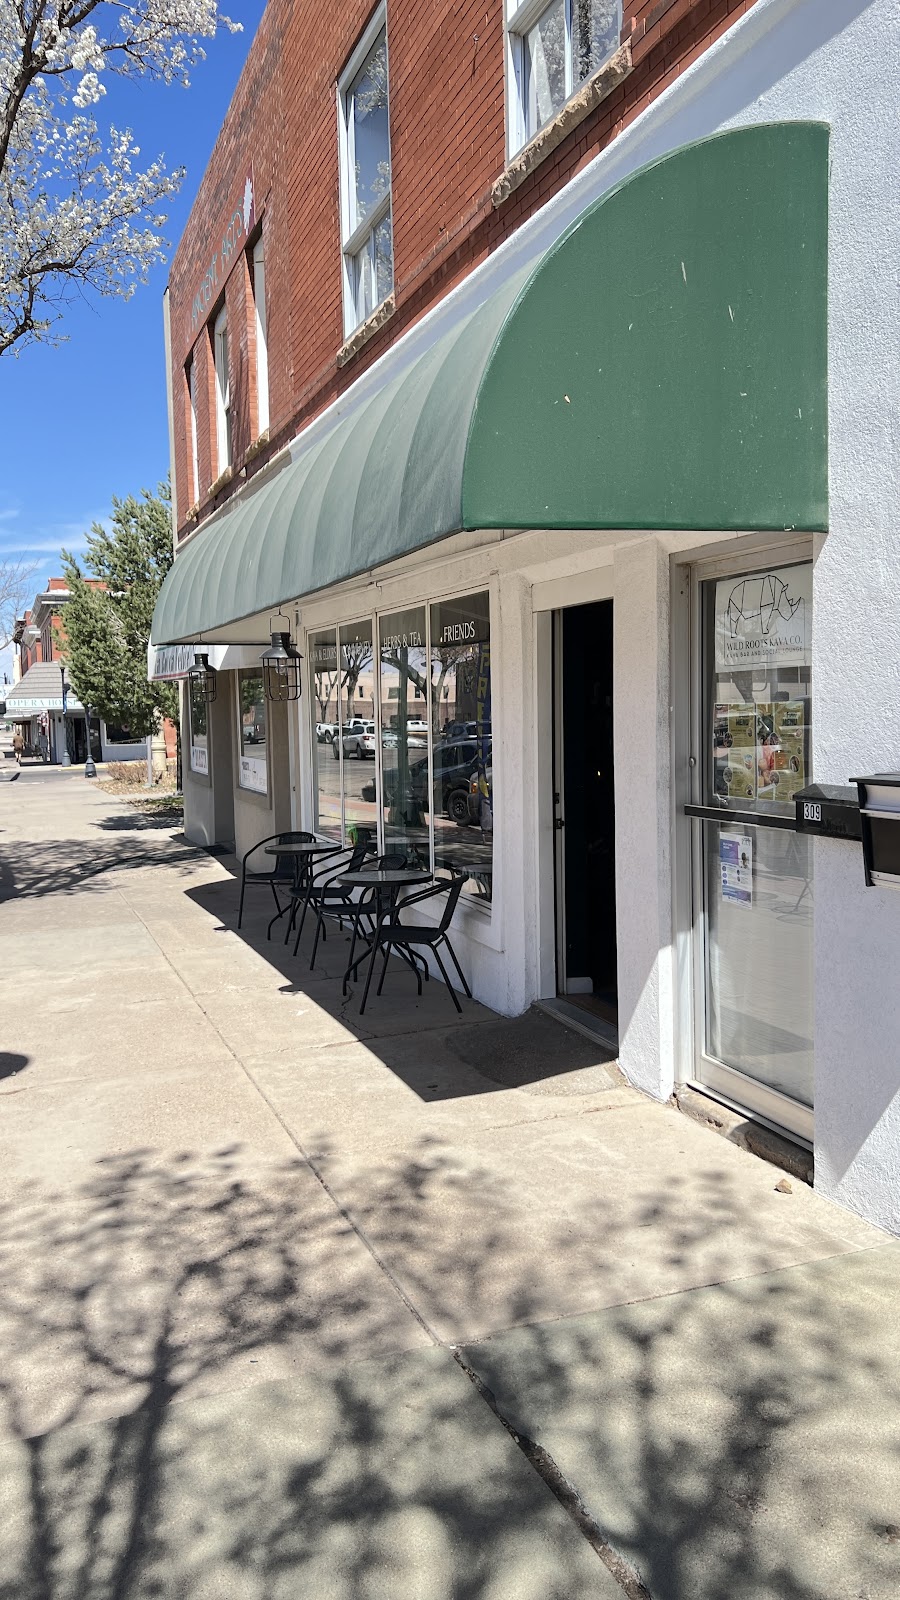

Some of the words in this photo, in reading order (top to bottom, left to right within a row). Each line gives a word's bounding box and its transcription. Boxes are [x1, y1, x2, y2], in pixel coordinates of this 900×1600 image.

[383, 635, 402, 649] HERBS
[402, 634, 408, 648] &
[410, 631, 422, 646] TEA
[443, 621, 475, 642] FRIENDS
[726, 641, 744, 651] WILD
[745, 638, 768, 649] ROOTS
[769, 636, 788, 647] KAVA
[789, 635, 803, 645] CO.
[804, 803, 820, 820] 309
